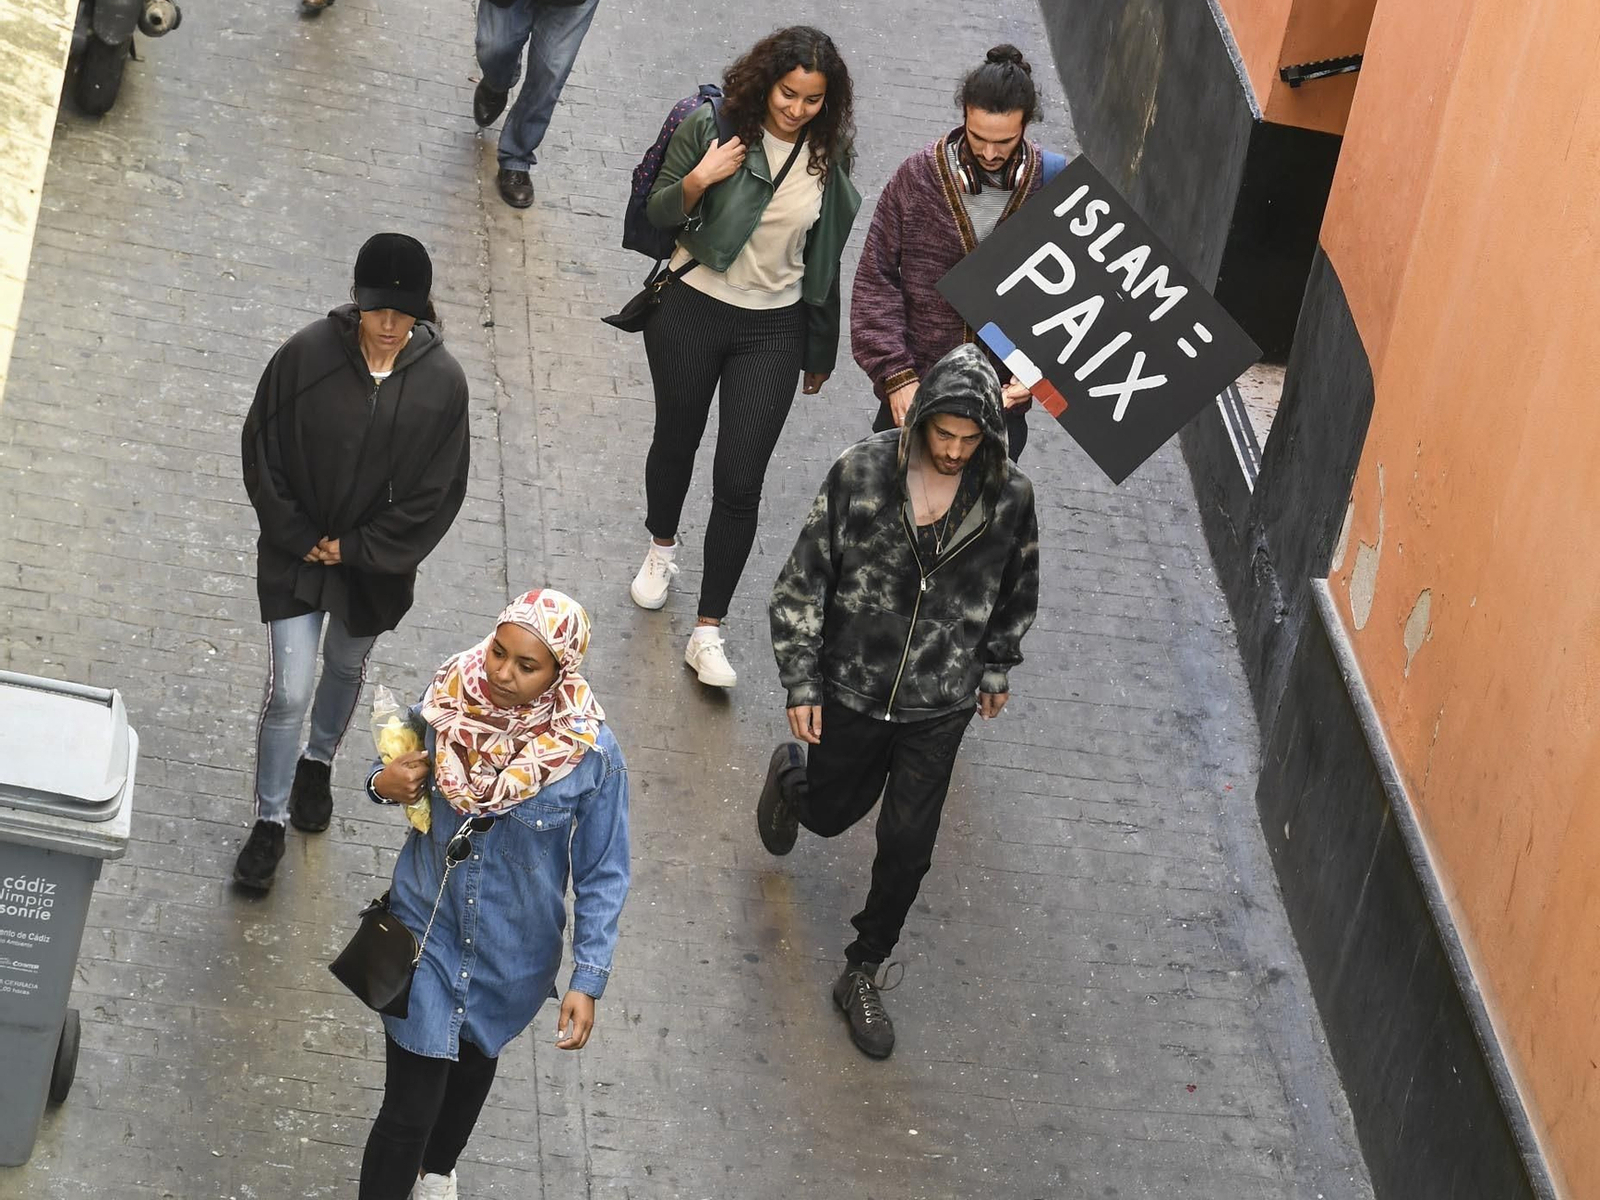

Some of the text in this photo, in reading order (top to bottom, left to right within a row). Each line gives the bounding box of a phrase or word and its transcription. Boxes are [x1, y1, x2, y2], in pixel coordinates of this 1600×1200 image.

[1053, 184, 1189, 322] ISLAM
[995, 241, 1169, 422] PAIX
[3, 875, 57, 895] cádiz
[17, 931, 27, 939] de
[28, 932, 50, 943] Cádiz
